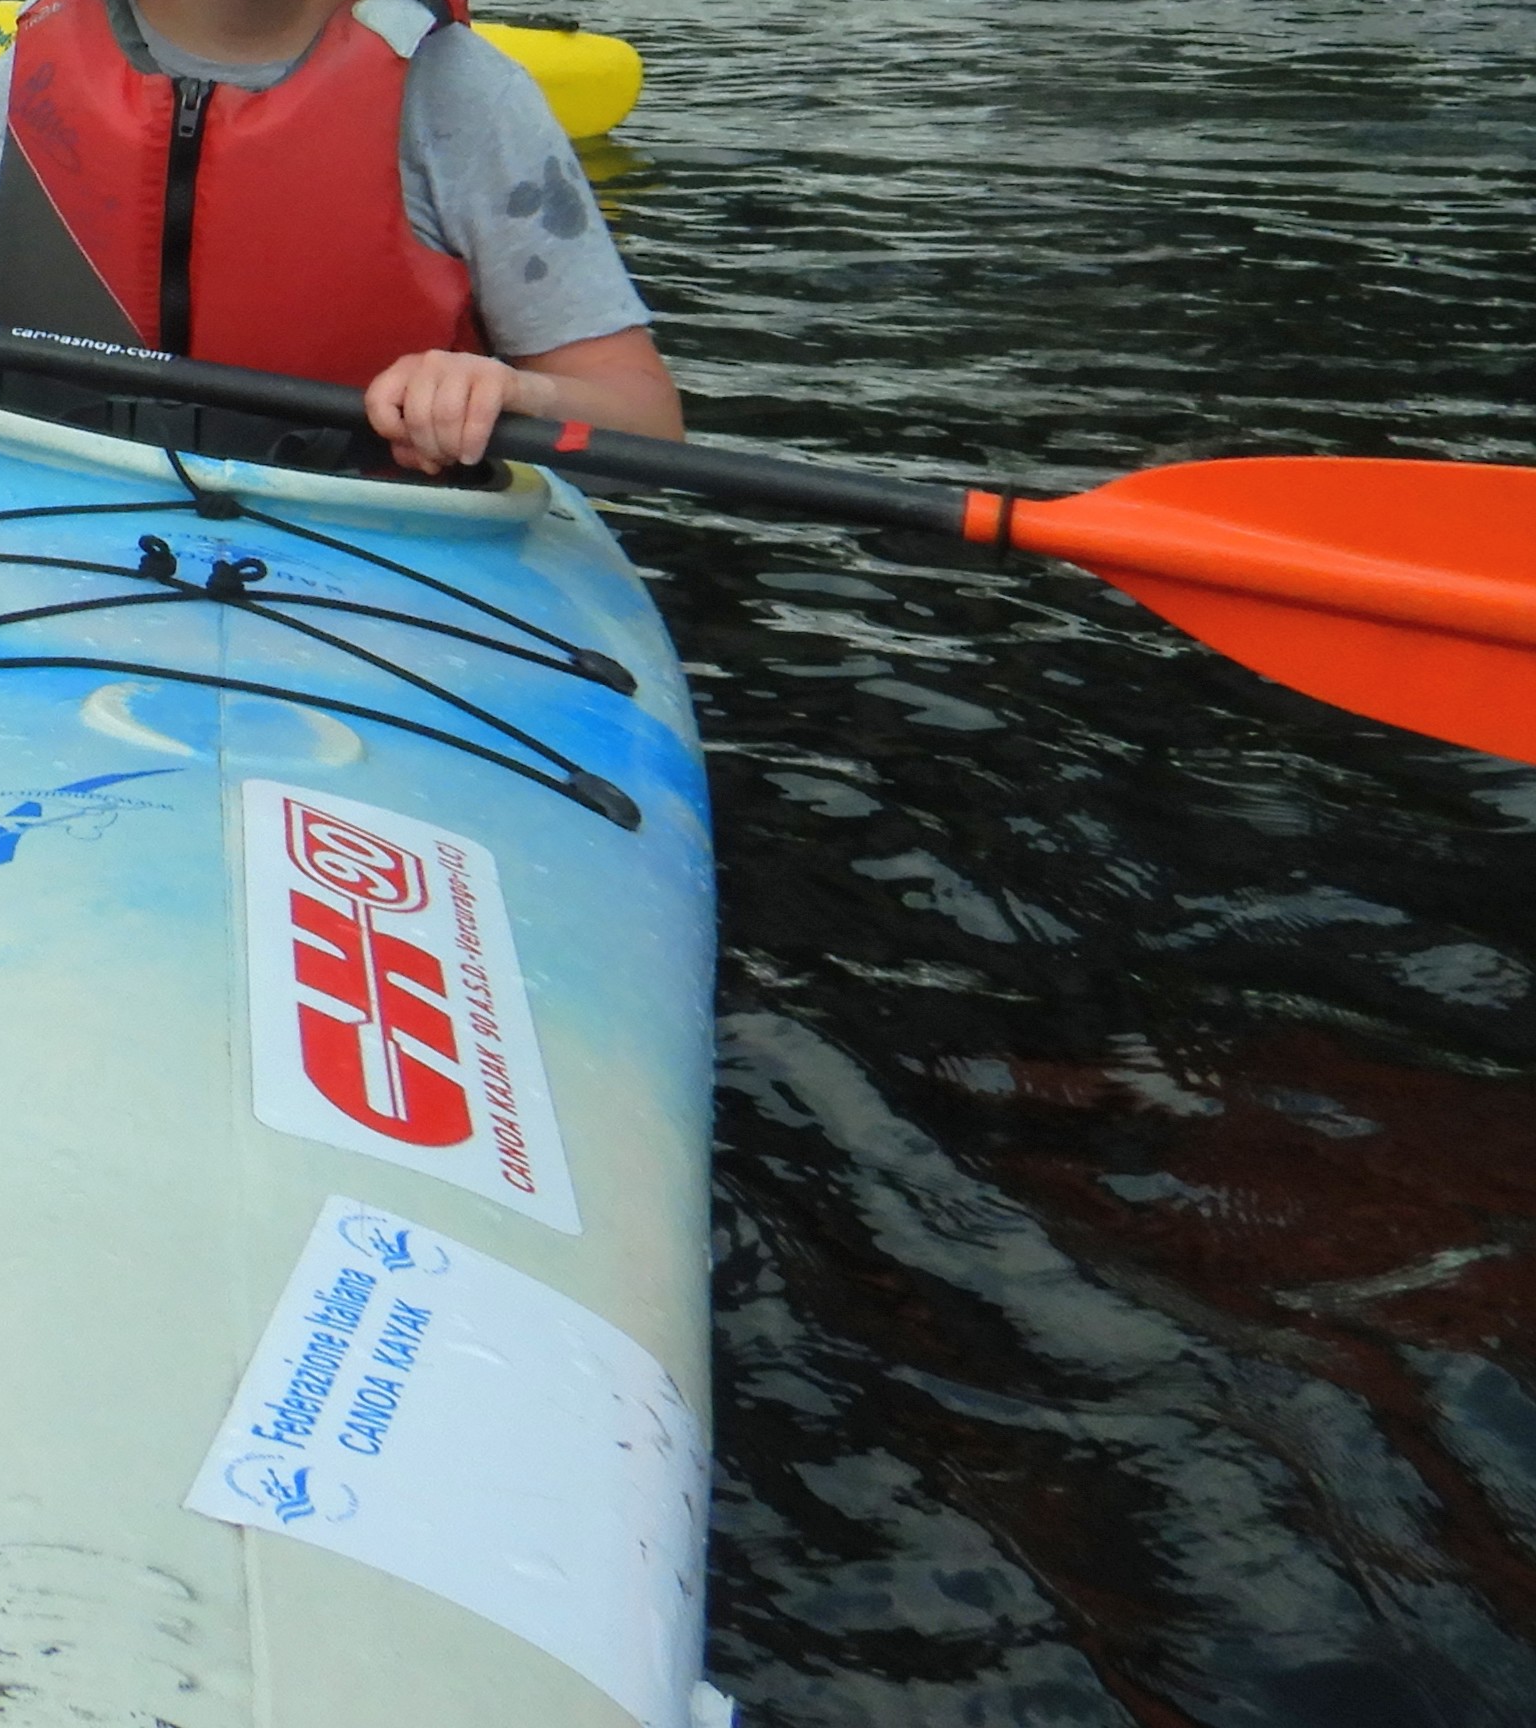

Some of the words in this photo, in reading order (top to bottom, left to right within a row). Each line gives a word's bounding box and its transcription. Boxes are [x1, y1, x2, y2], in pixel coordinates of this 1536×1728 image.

[308, 822, 399, 901] 90
[468, 1011, 502, 1042] 90
[475, 1041, 518, 1116] KAJAK
[489, 1111, 535, 1194] CANOA
[250, 1331, 351, 1450] Federazione
[303, 1267, 378, 1335] Italiana
[371, 1297, 433, 1373] KAYAK
[337, 1374, 406, 1456] CANOA
